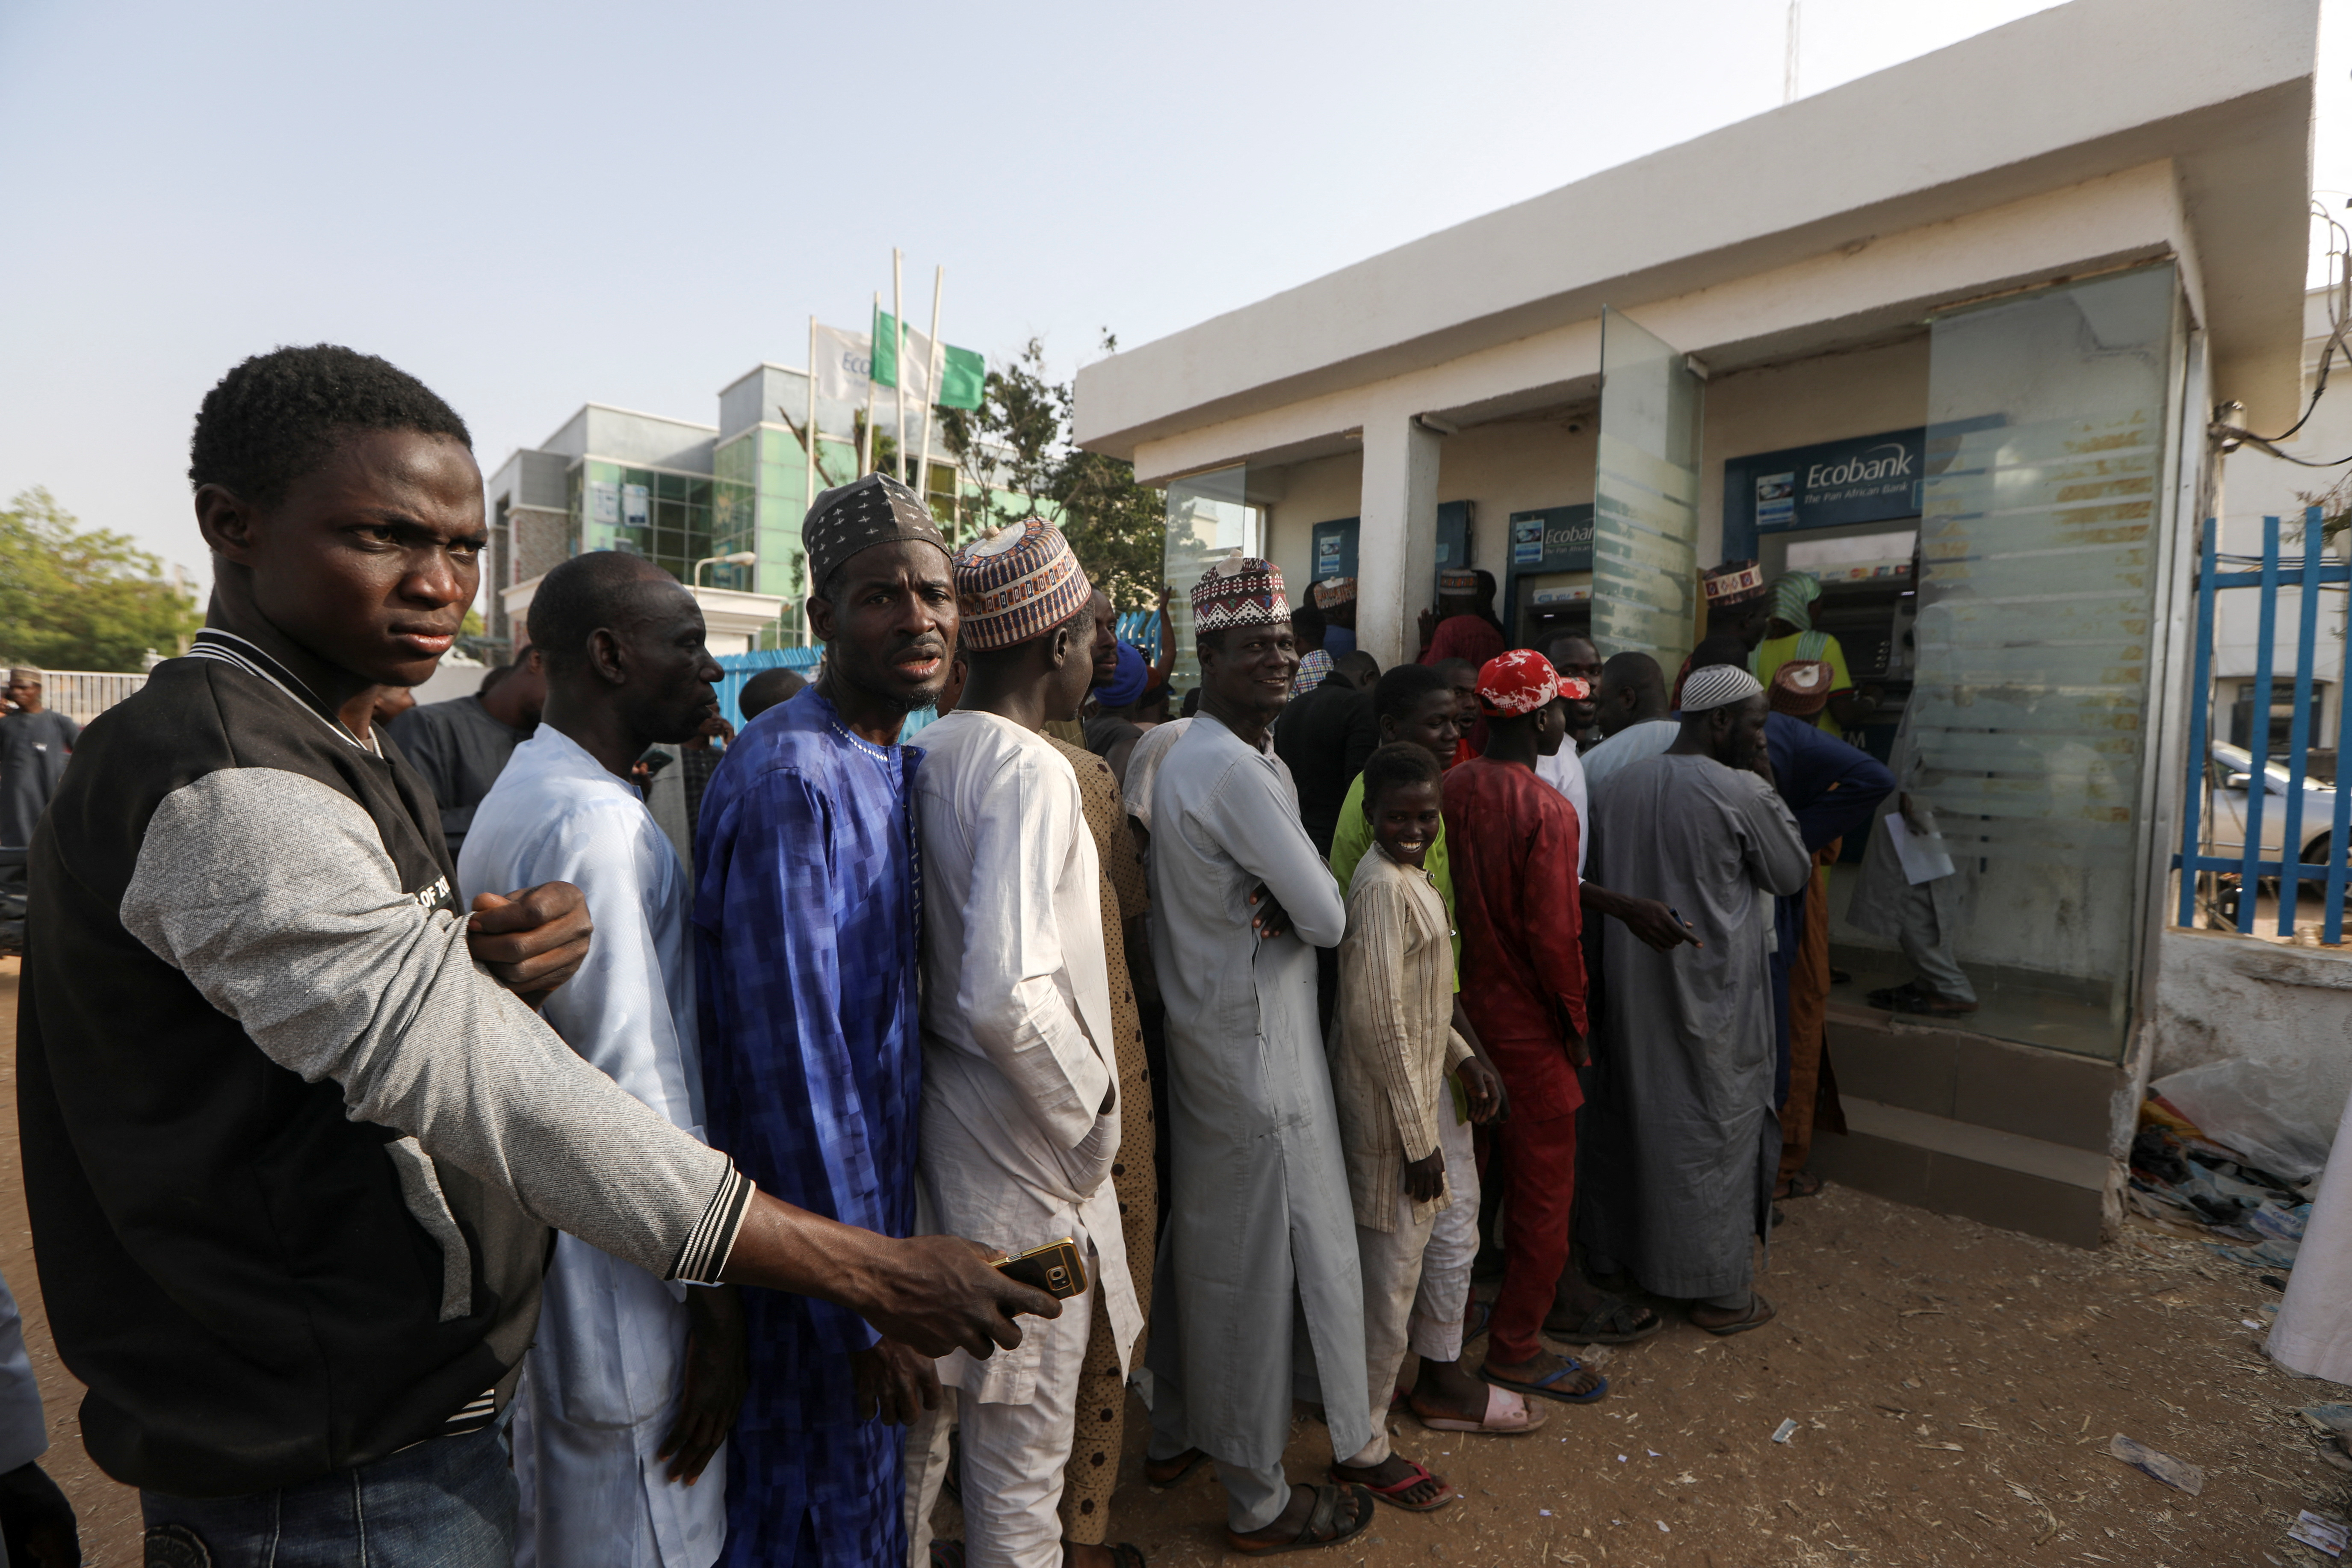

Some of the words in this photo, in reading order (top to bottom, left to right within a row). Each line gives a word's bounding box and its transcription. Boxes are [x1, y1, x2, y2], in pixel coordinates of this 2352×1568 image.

[1806, 443, 1914, 489] Ecobank
[1804, 493, 1821, 505] The
[1823, 491, 1841, 502] Pan
[1845, 486, 1880, 499] African
[1882, 481, 1909, 495] Bank
[420, 886, 436, 908] OF
